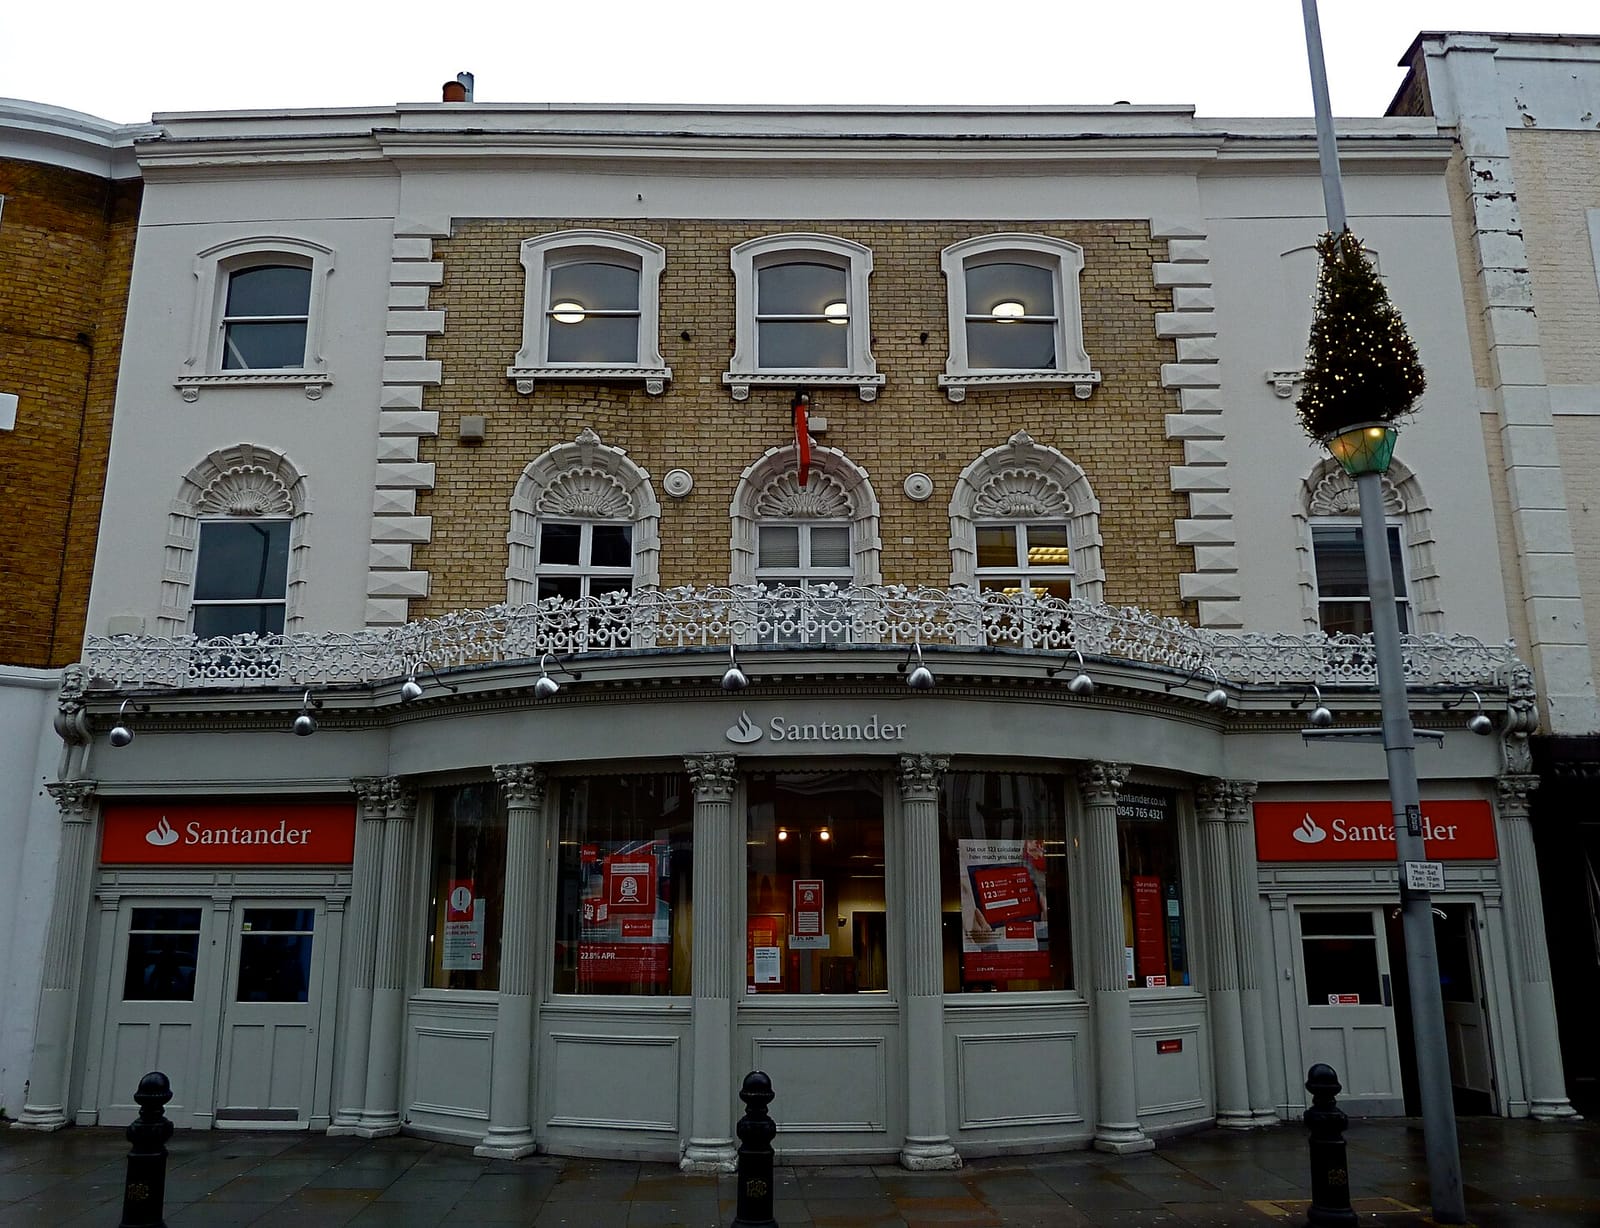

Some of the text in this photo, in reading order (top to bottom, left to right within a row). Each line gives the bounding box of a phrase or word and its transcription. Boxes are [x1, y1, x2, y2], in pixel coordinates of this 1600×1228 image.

[770, 713, 908, 742] Santander
[1116, 806, 1164, 820] 0845 765 4321
[185, 819, 312, 845] Santander
[1331, 816, 1458, 842] Santader
[580, 952, 601, 960] 22.8%
[601, 952, 616, 960] APR
